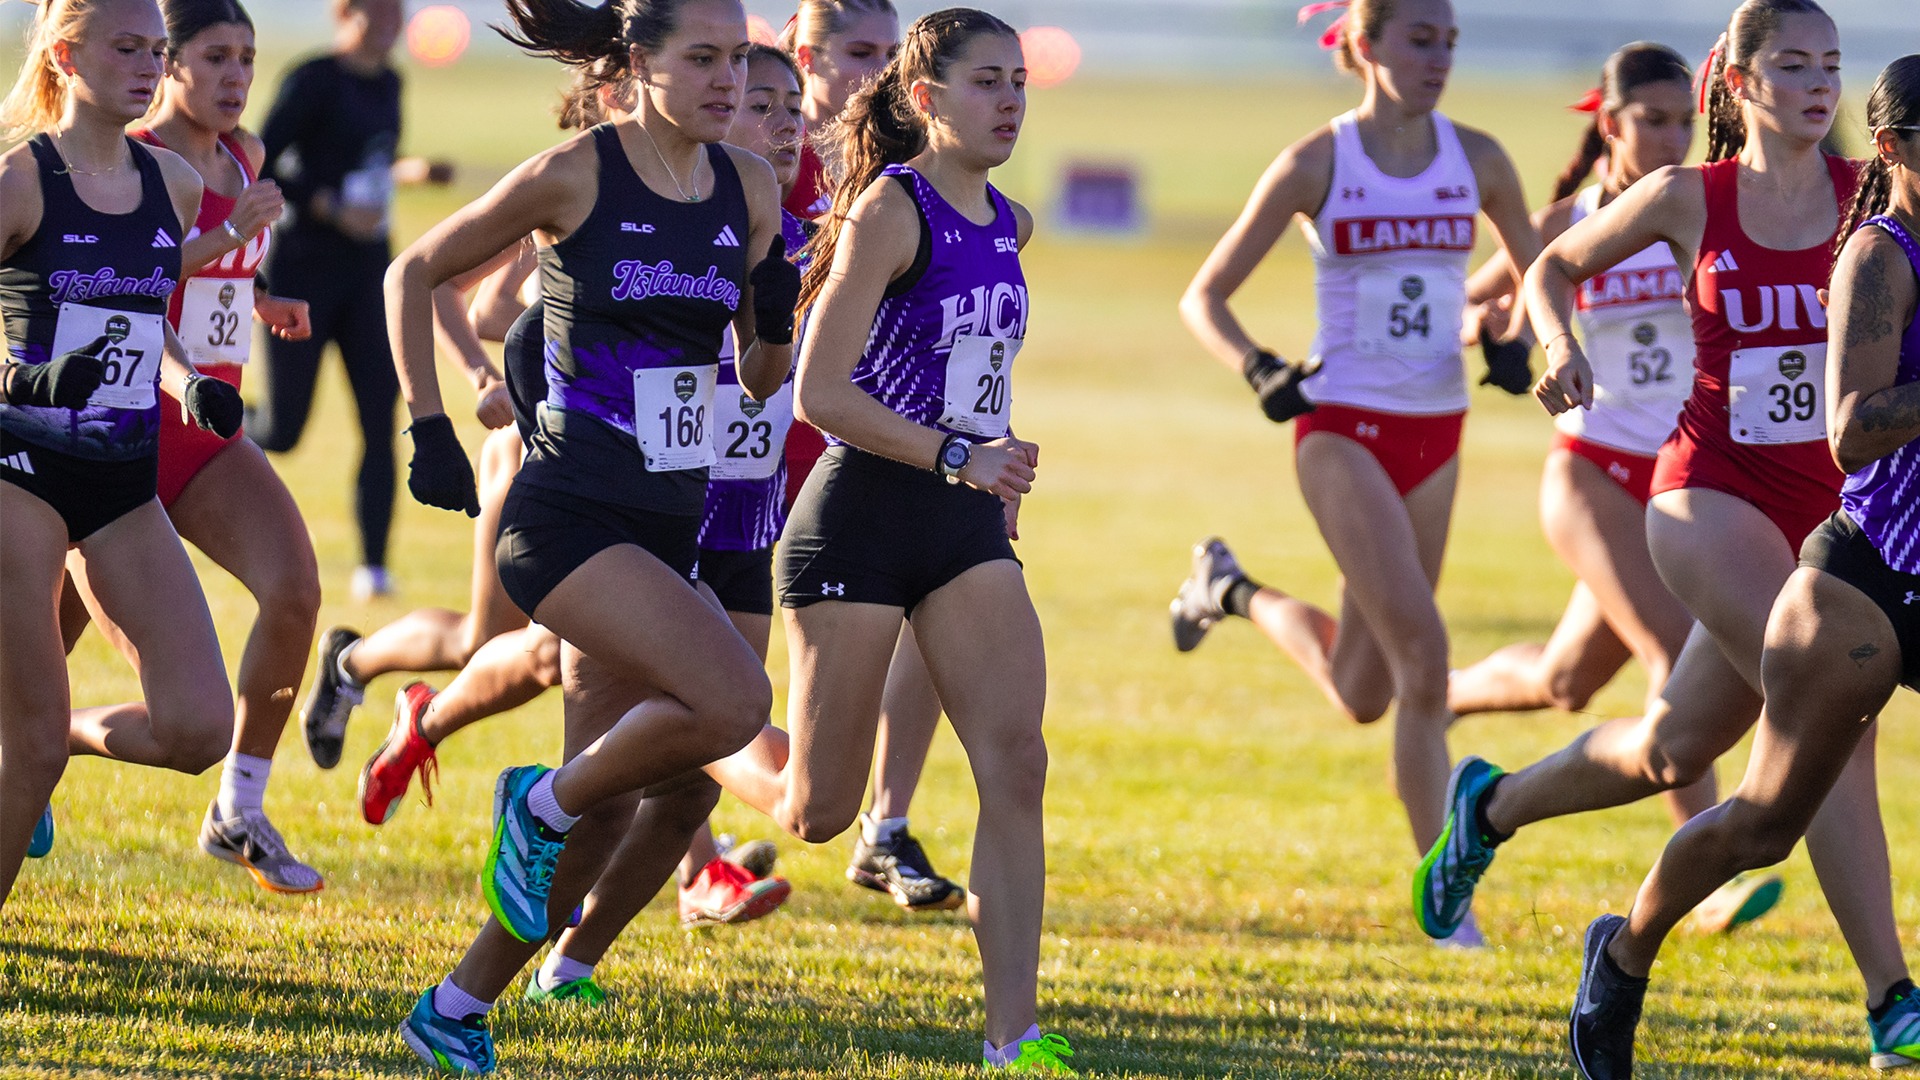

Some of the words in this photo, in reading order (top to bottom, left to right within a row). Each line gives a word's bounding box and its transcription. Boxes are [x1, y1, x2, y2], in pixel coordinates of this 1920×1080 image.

[63, 234, 99, 243] SLC
[621, 222, 656, 233] SLC
[994, 237, 1018, 253] SLC
[1582, 271, 1683, 303] LAMA
[207, 309, 240, 347] 32
[1389, 302, 1431, 338] 54
[1629, 347, 1673, 384] 52
[973, 374, 1004, 415] 20
[1768, 381, 1817, 423] 39
[659, 404, 705, 448] 168
[725, 420, 772, 459] 23
